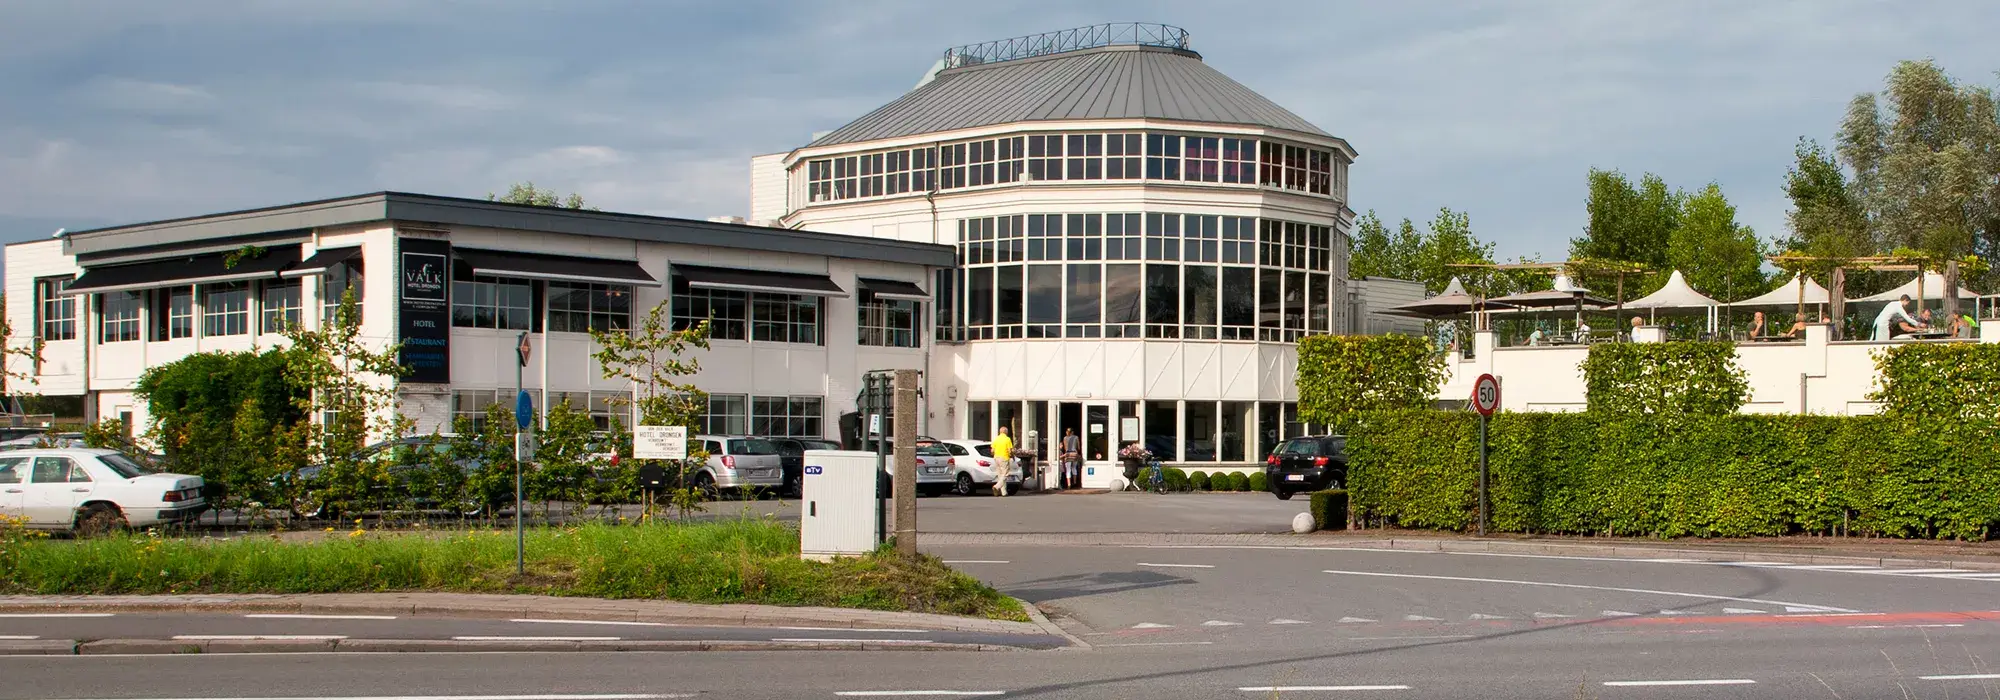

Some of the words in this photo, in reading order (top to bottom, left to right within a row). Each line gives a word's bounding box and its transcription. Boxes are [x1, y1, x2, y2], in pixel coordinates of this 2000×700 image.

[406, 272, 442, 284] VALK
[413, 320, 436, 328] HOTEL
[403, 338, 446, 346] RESTAURANT
[1480, 387, 1495, 402] 50
